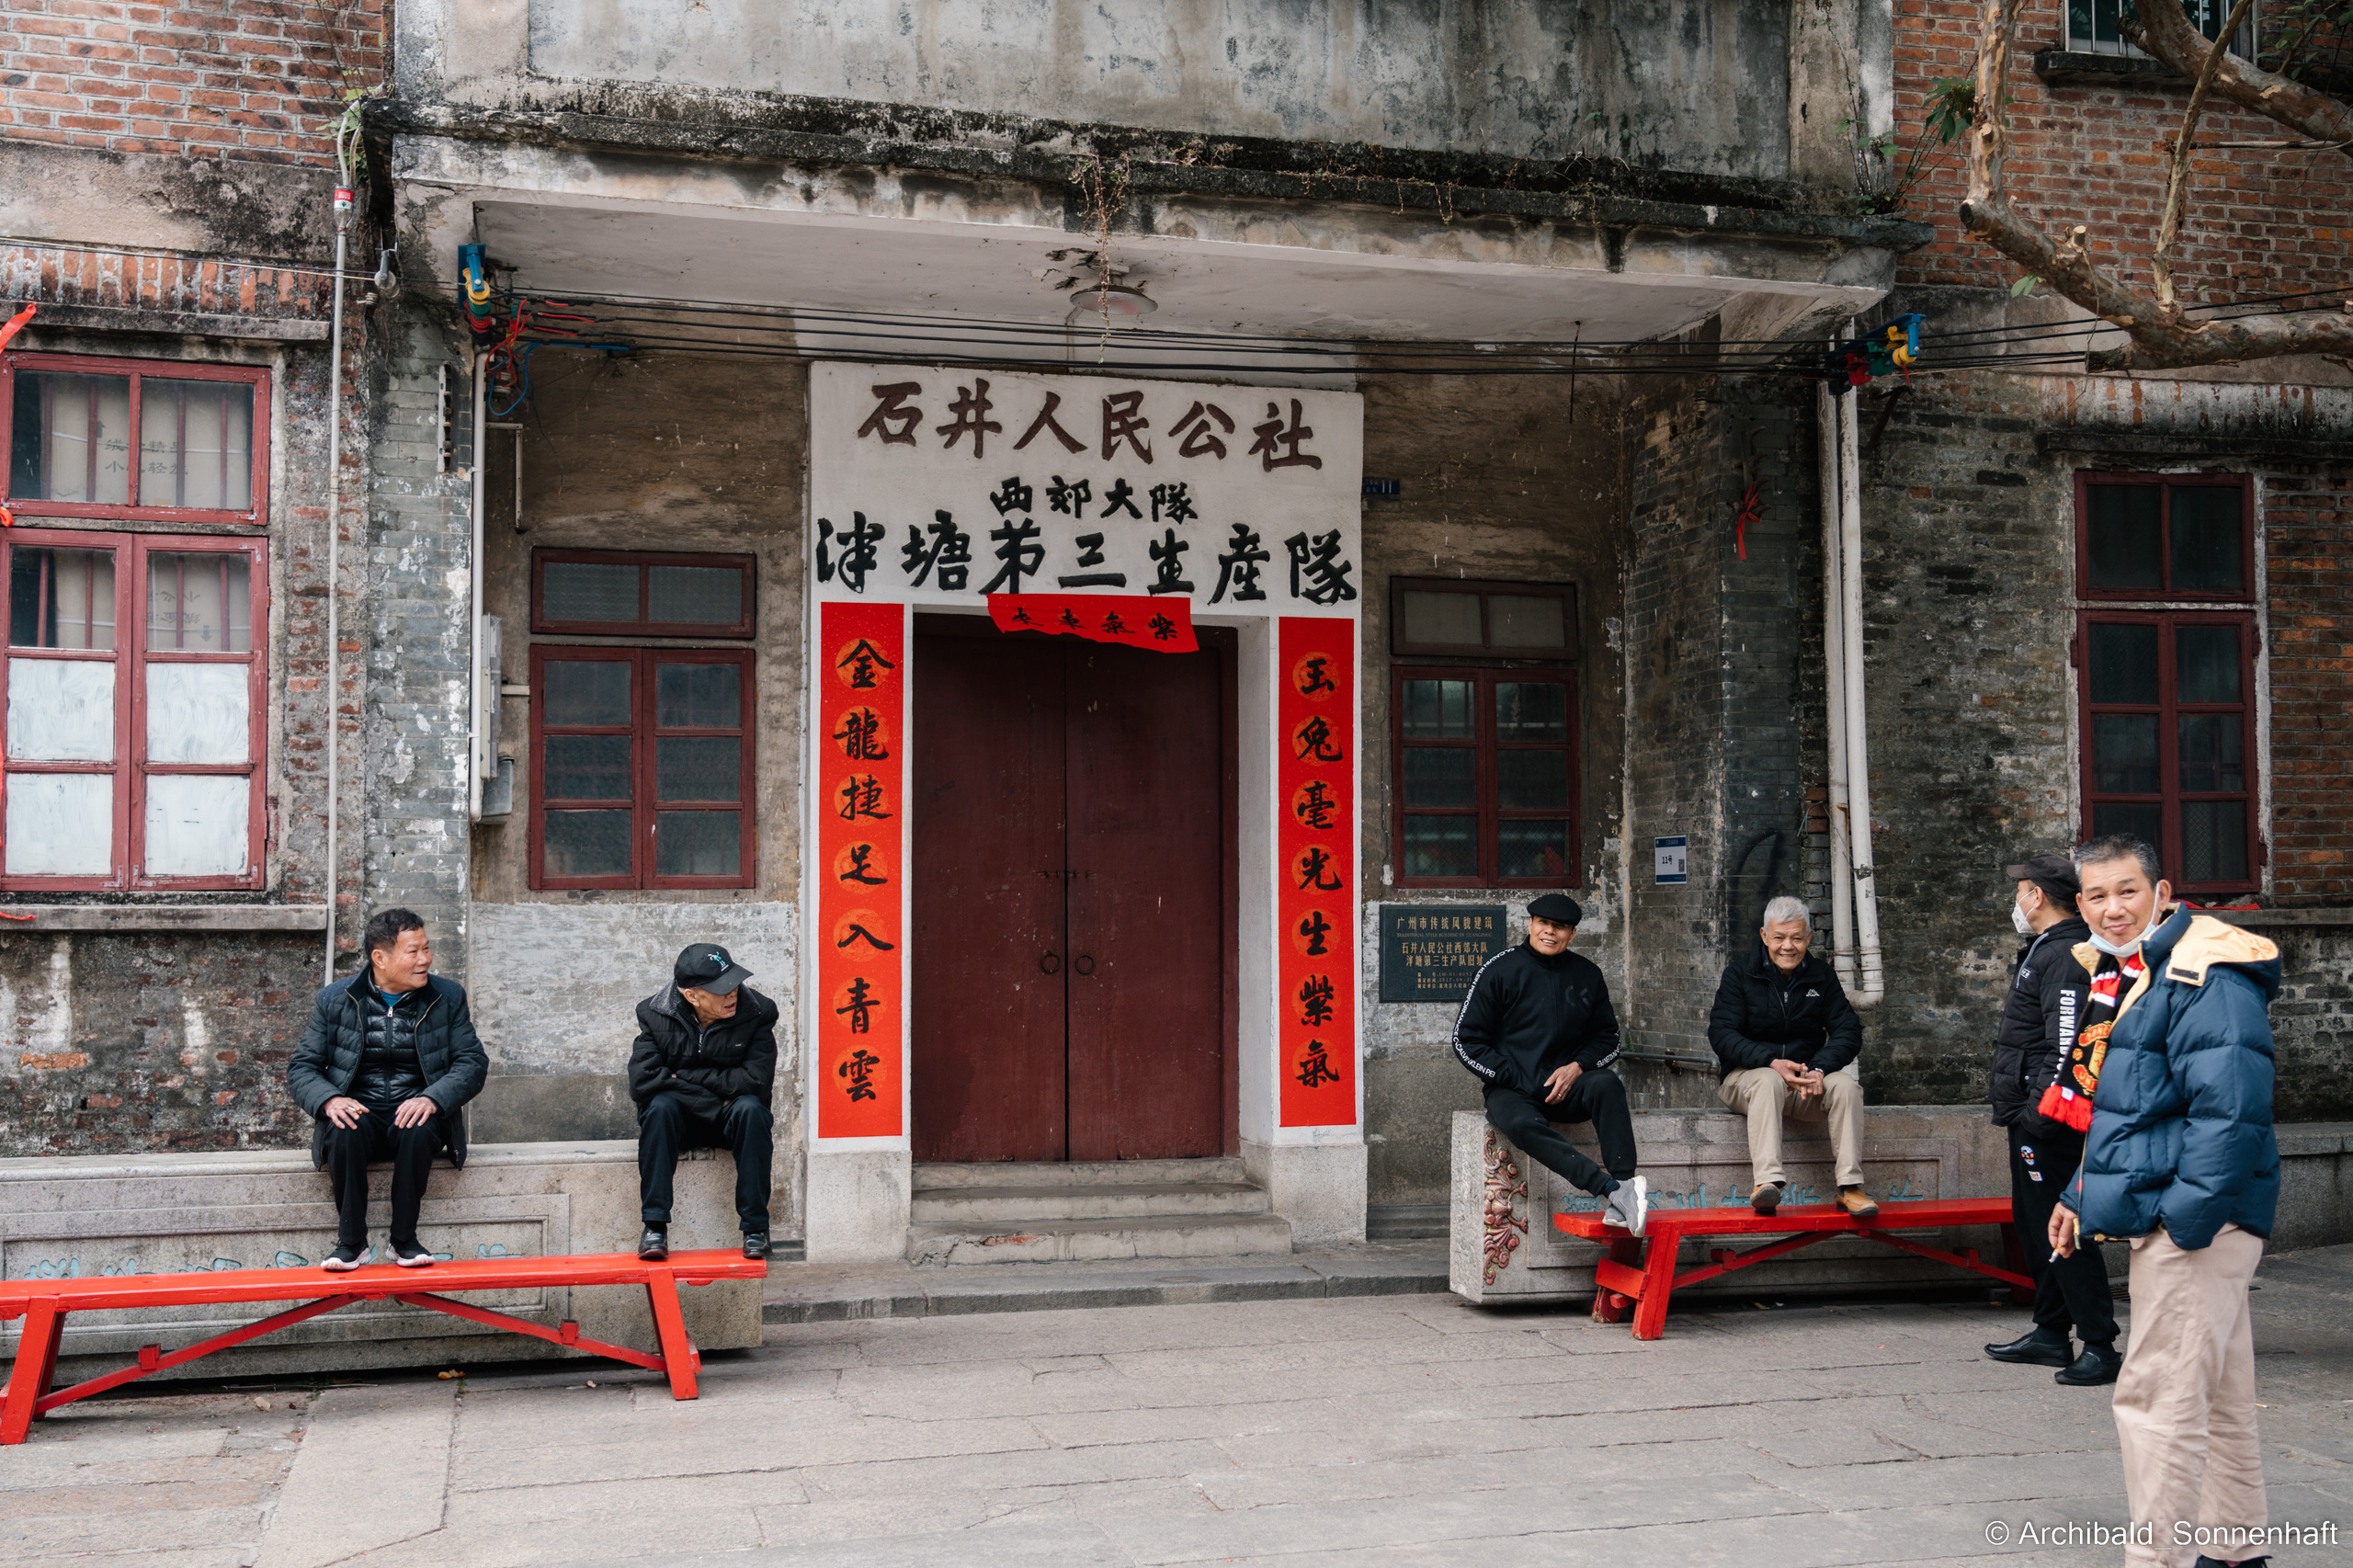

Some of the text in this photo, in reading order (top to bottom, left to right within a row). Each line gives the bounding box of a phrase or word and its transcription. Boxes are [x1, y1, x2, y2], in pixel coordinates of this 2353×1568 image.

[857, 378, 1323, 472] 石井人民公社
[990, 475, 1198, 524] 西郊大隊
[833, 639, 895, 1102] 金龍捷足入青雲
[1296, 658, 1343, 1088] 玉兔毫光生紫氣
[1397, 916, 1493, 930] 广州市传统风貌建筑
[1402, 942, 1488, 954] 石井人民公社西郊大队
[1472, 966, 1485, 985] KLEIN
